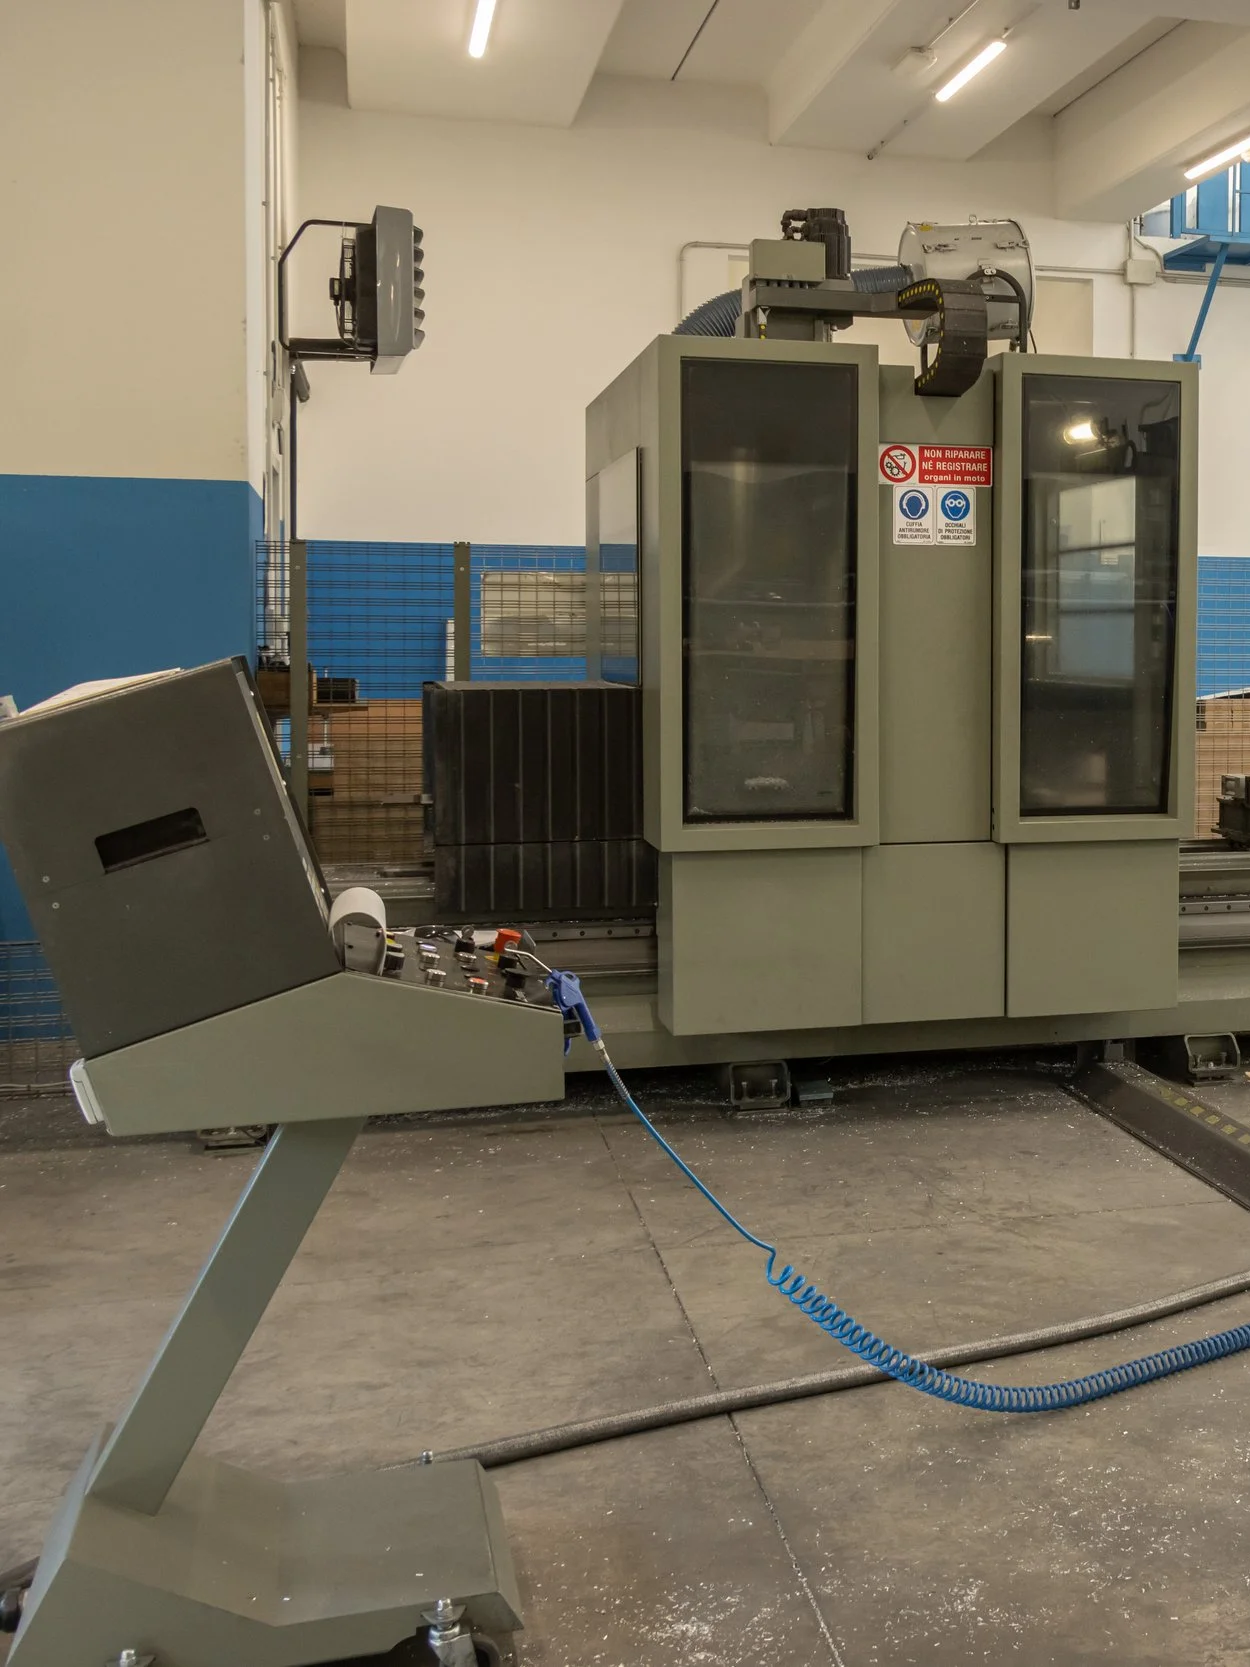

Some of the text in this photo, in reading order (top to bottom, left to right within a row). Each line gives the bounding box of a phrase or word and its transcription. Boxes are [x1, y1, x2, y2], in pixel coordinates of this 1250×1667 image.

[924, 449, 986, 459] NON RIPARARE
[936, 462, 988, 471] REGISTRARE
[924, 474, 951, 482] organi
[953, 474, 961, 482] in
